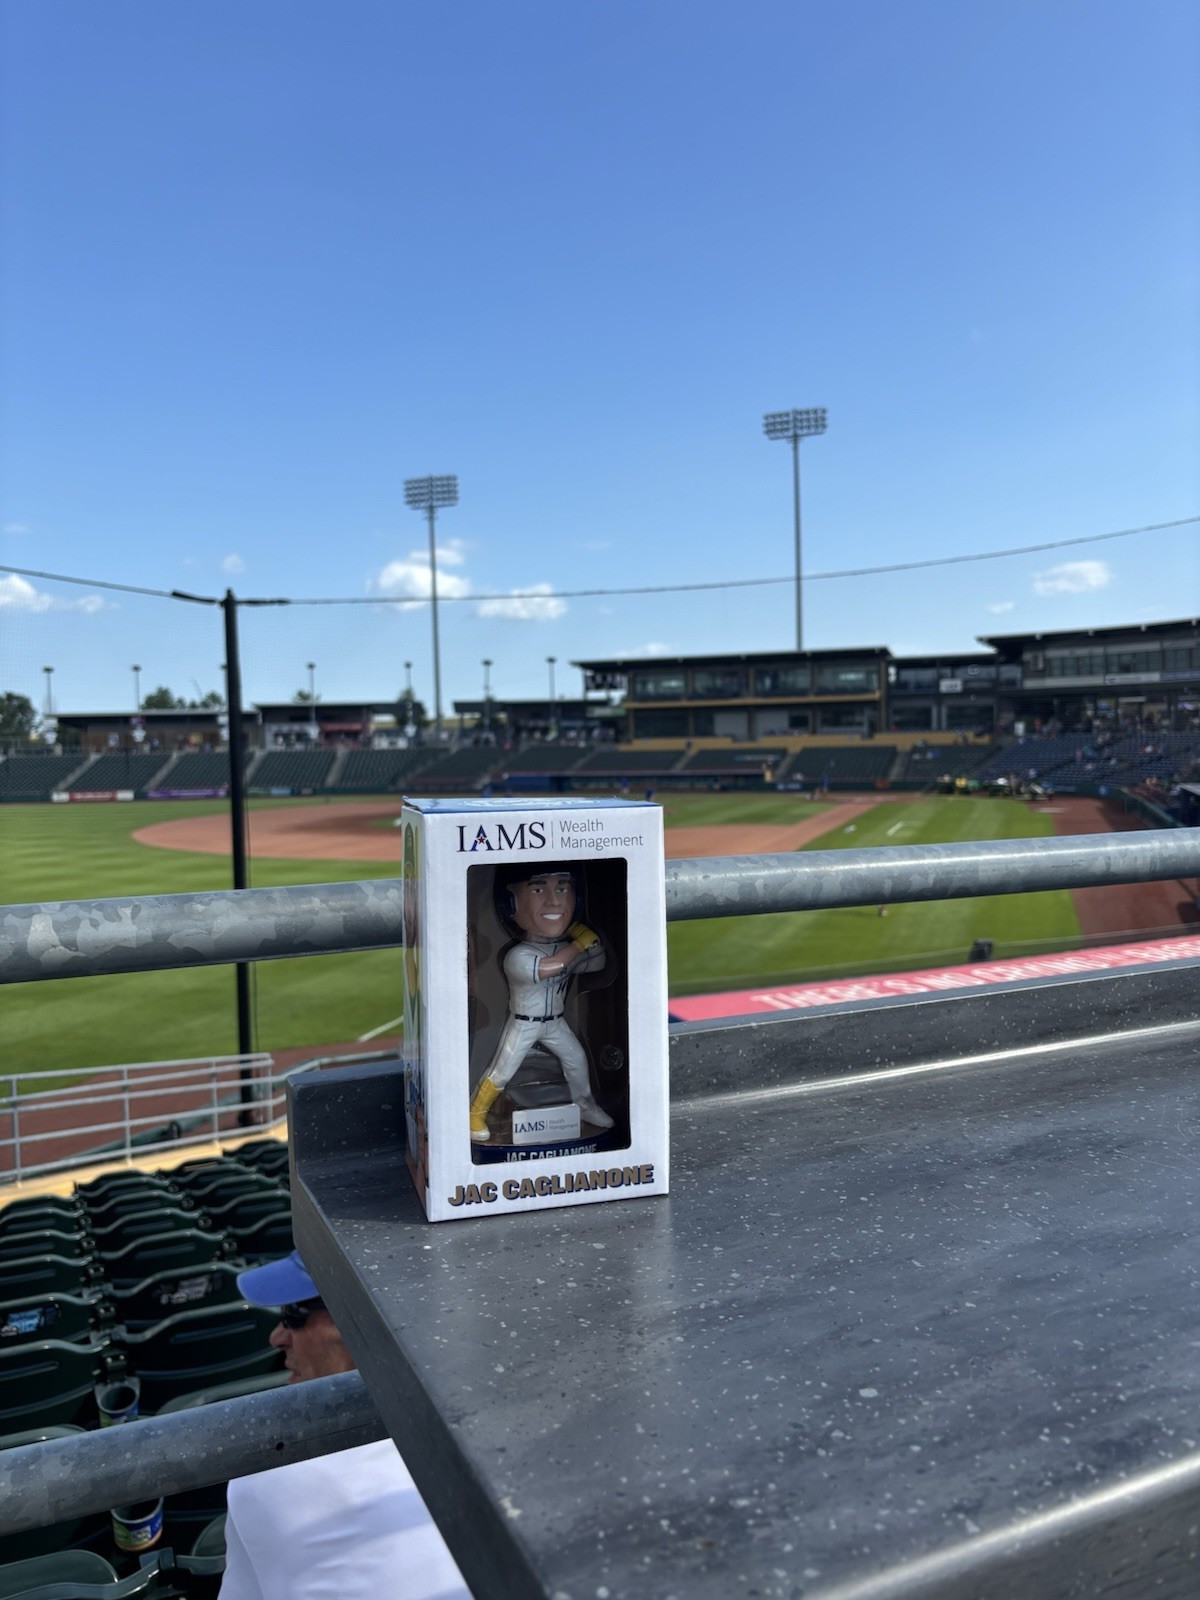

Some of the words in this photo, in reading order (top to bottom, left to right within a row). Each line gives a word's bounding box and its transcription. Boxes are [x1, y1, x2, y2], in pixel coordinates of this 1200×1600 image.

[559, 819, 604, 833] Wealth
[456, 821, 547, 852] IAMS
[560, 834, 644, 850] Management
[514, 1121, 545, 1133] IAMS
[504, 1151, 526, 1163] JAC
[448, 1182, 498, 1207] JAC
[502, 1164, 655, 1200] CAGLIANONE
